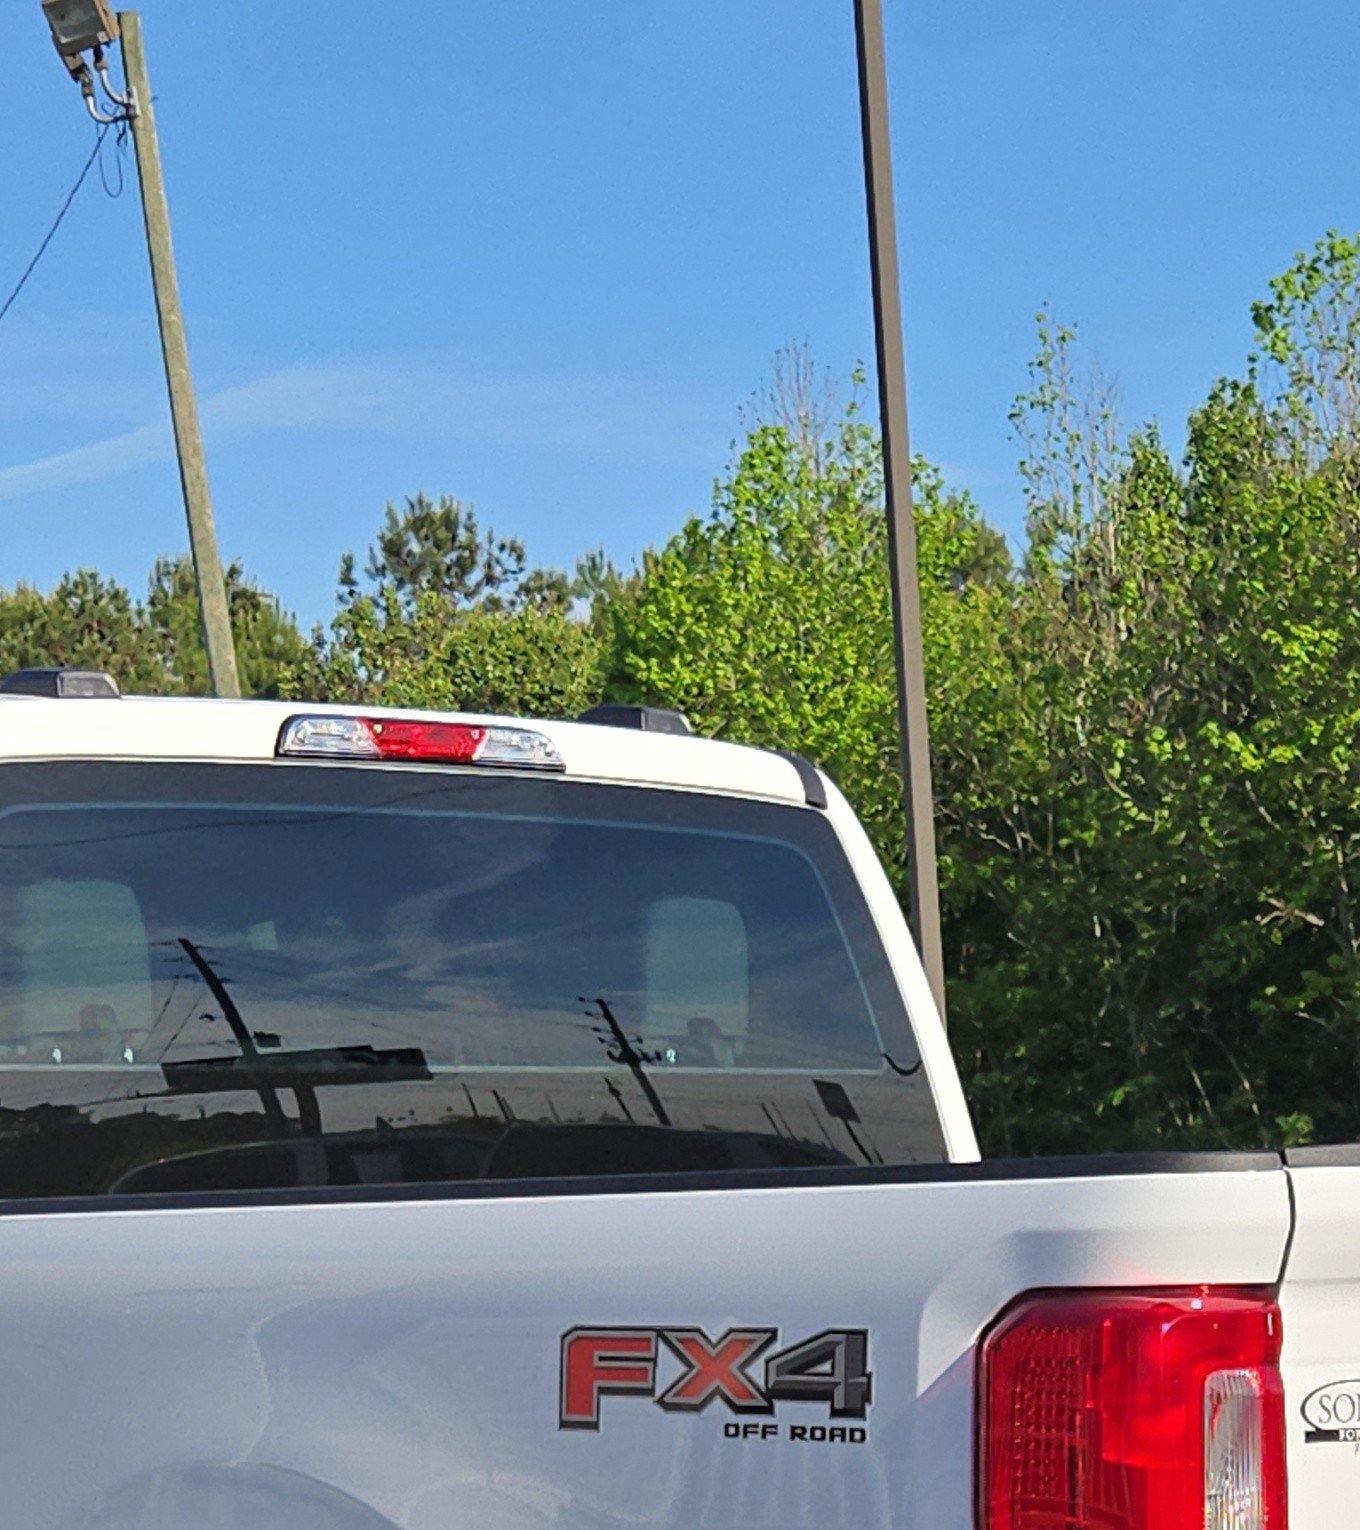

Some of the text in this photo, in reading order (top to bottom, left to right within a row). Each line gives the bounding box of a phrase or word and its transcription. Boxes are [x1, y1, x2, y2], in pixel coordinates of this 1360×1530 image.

[558, 1324, 872, 1431] FX4
[724, 1423, 867, 1444] OFF ROAD
